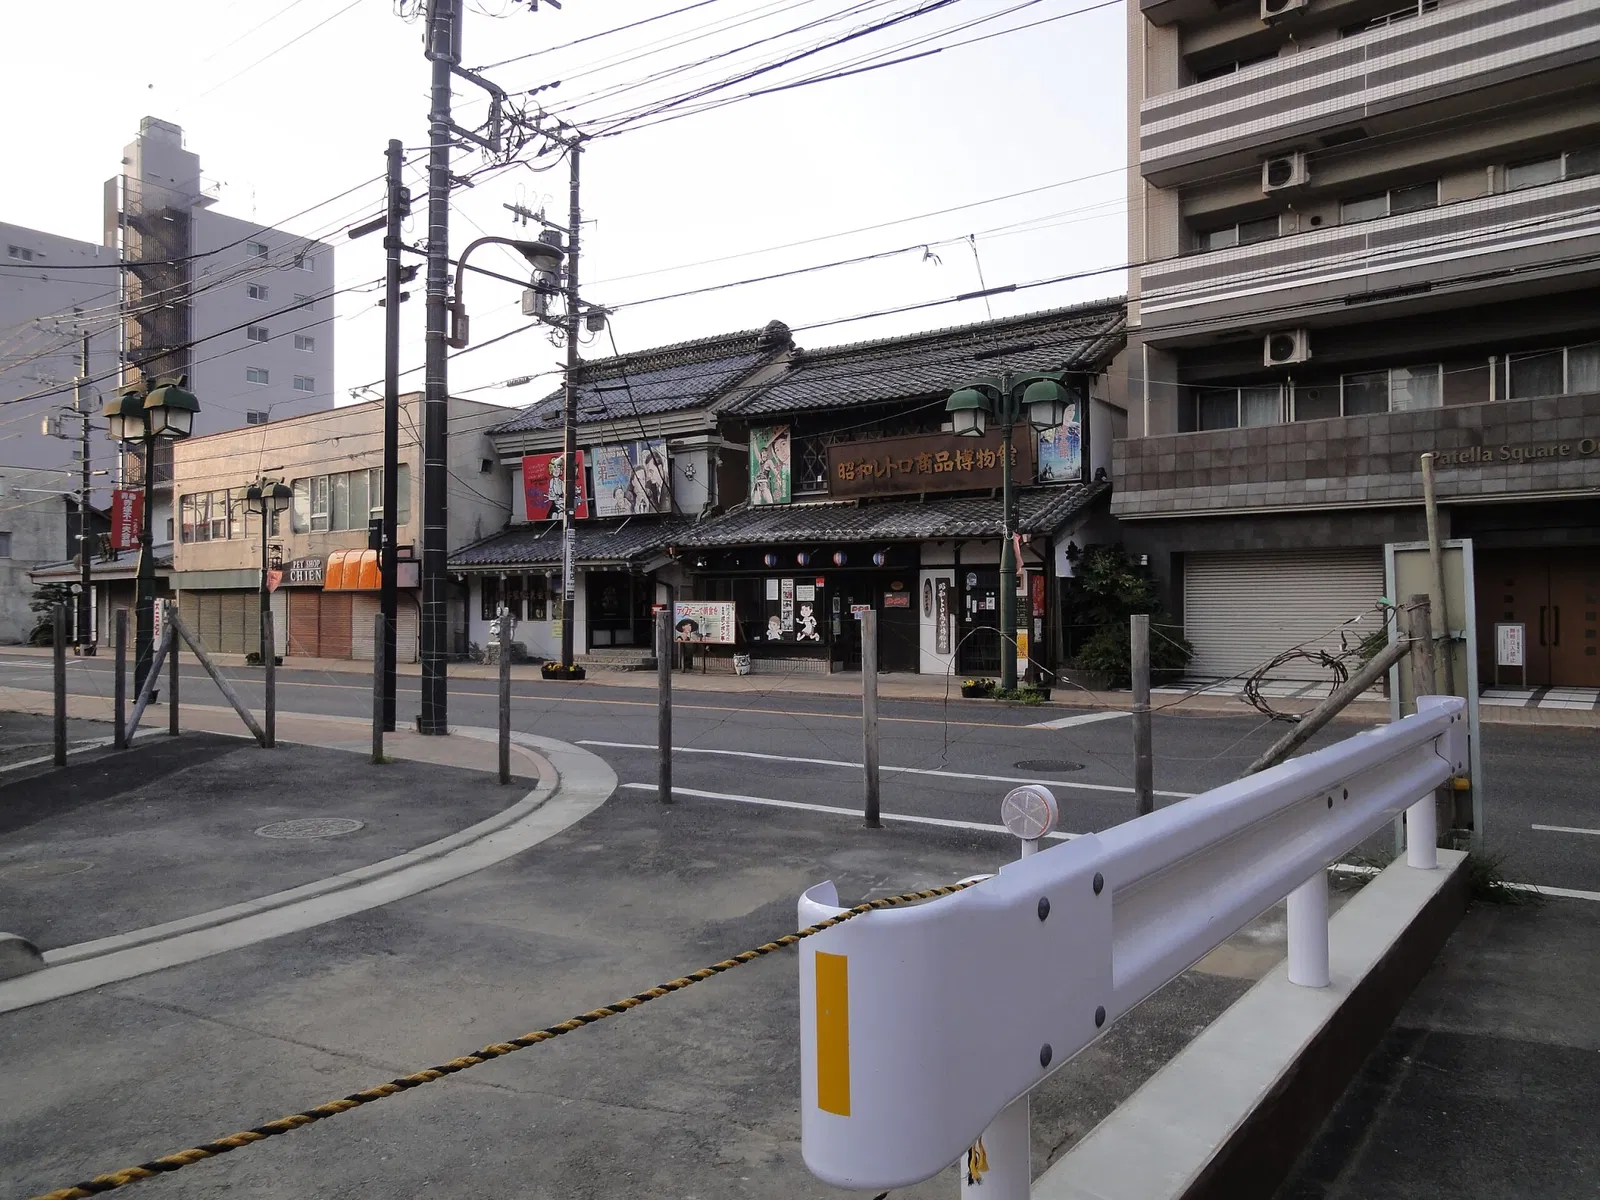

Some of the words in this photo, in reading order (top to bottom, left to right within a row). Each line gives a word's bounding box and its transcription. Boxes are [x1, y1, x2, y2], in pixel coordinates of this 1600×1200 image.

[838, 444, 1018, 481] 昭和レトロ商品博物館
[1432, 446, 1493, 466] Patella
[1500, 444, 1570, 464] Square
[293, 560, 305, 569] PET
[306, 559, 321, 568] SHOP
[290, 569, 323, 581] CHIEN
